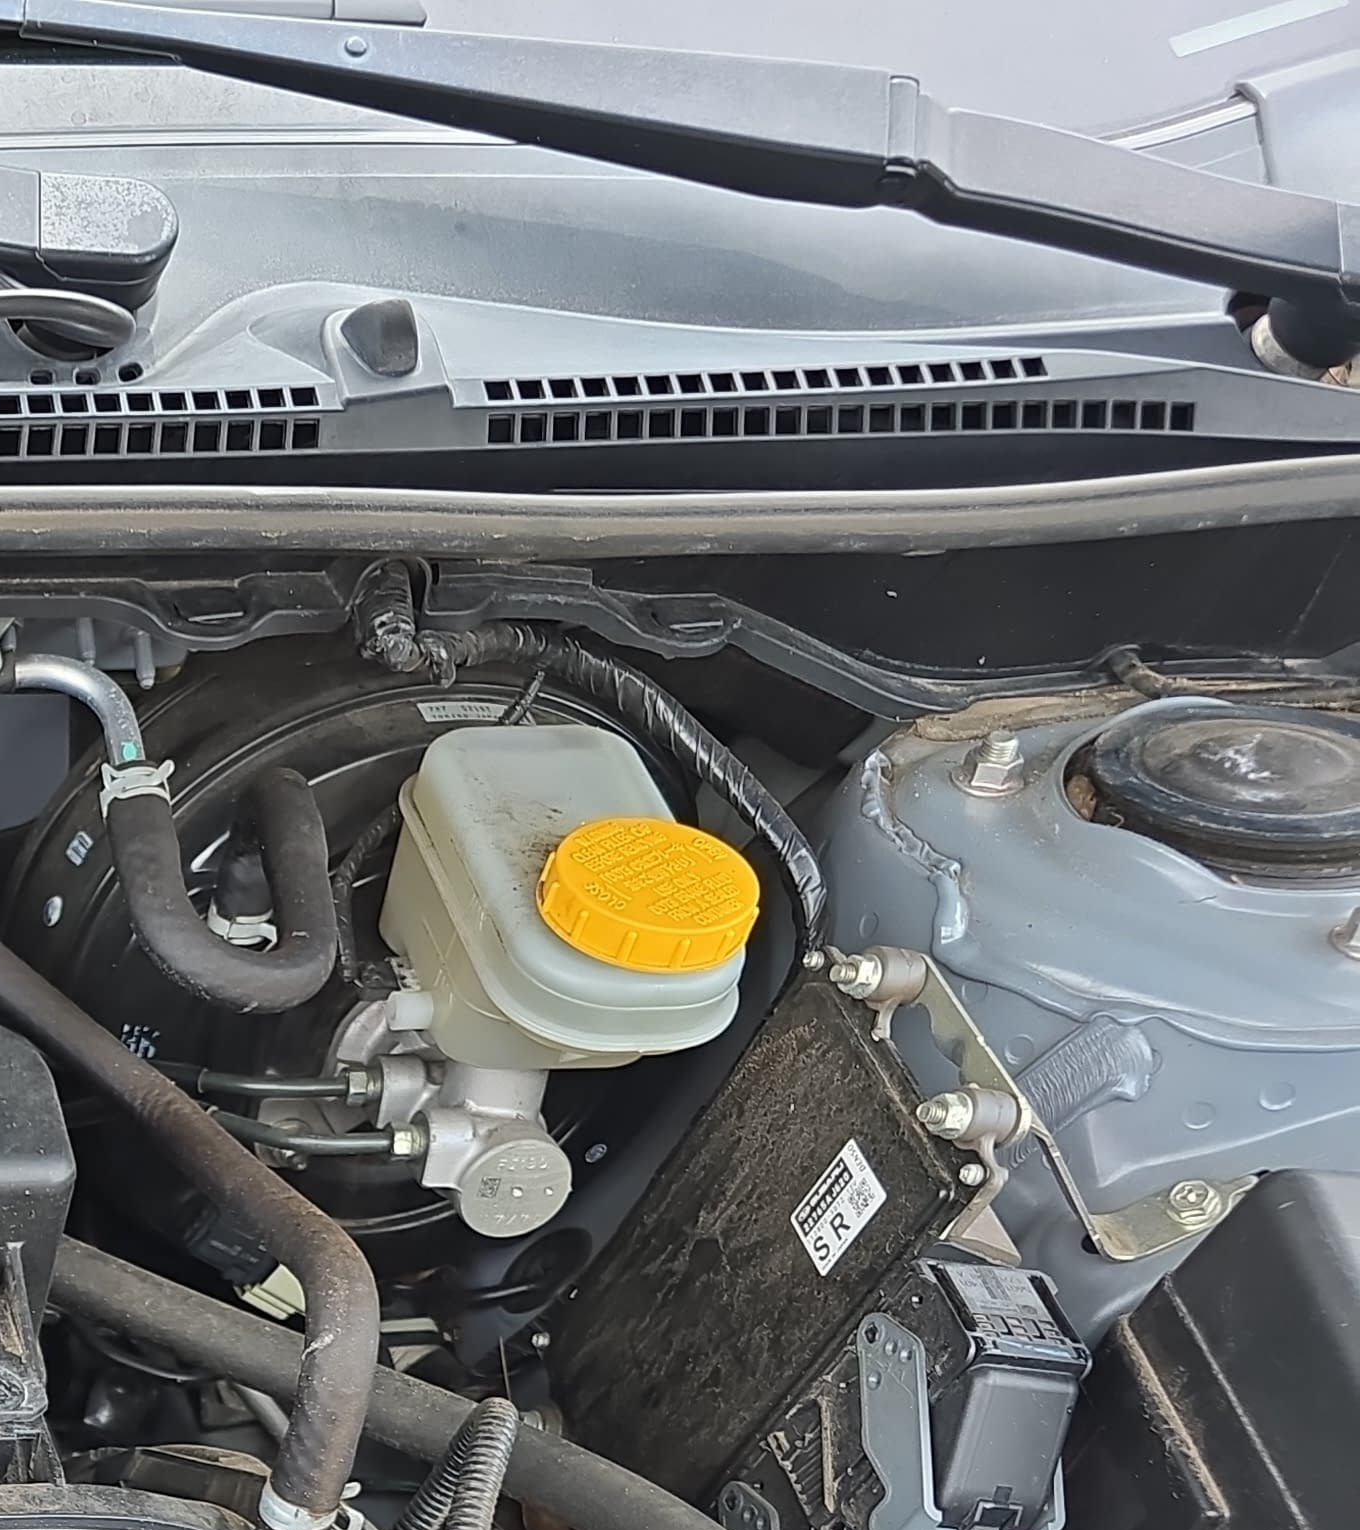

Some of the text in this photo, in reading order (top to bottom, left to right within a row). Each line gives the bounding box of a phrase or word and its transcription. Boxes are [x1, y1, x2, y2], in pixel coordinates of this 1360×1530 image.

[693, 838, 728, 860] OPEN
[584, 881, 626, 910] CLOSE
[847, 1144, 867, 1173] DENSO
[813, 1212, 851, 1261] S R
